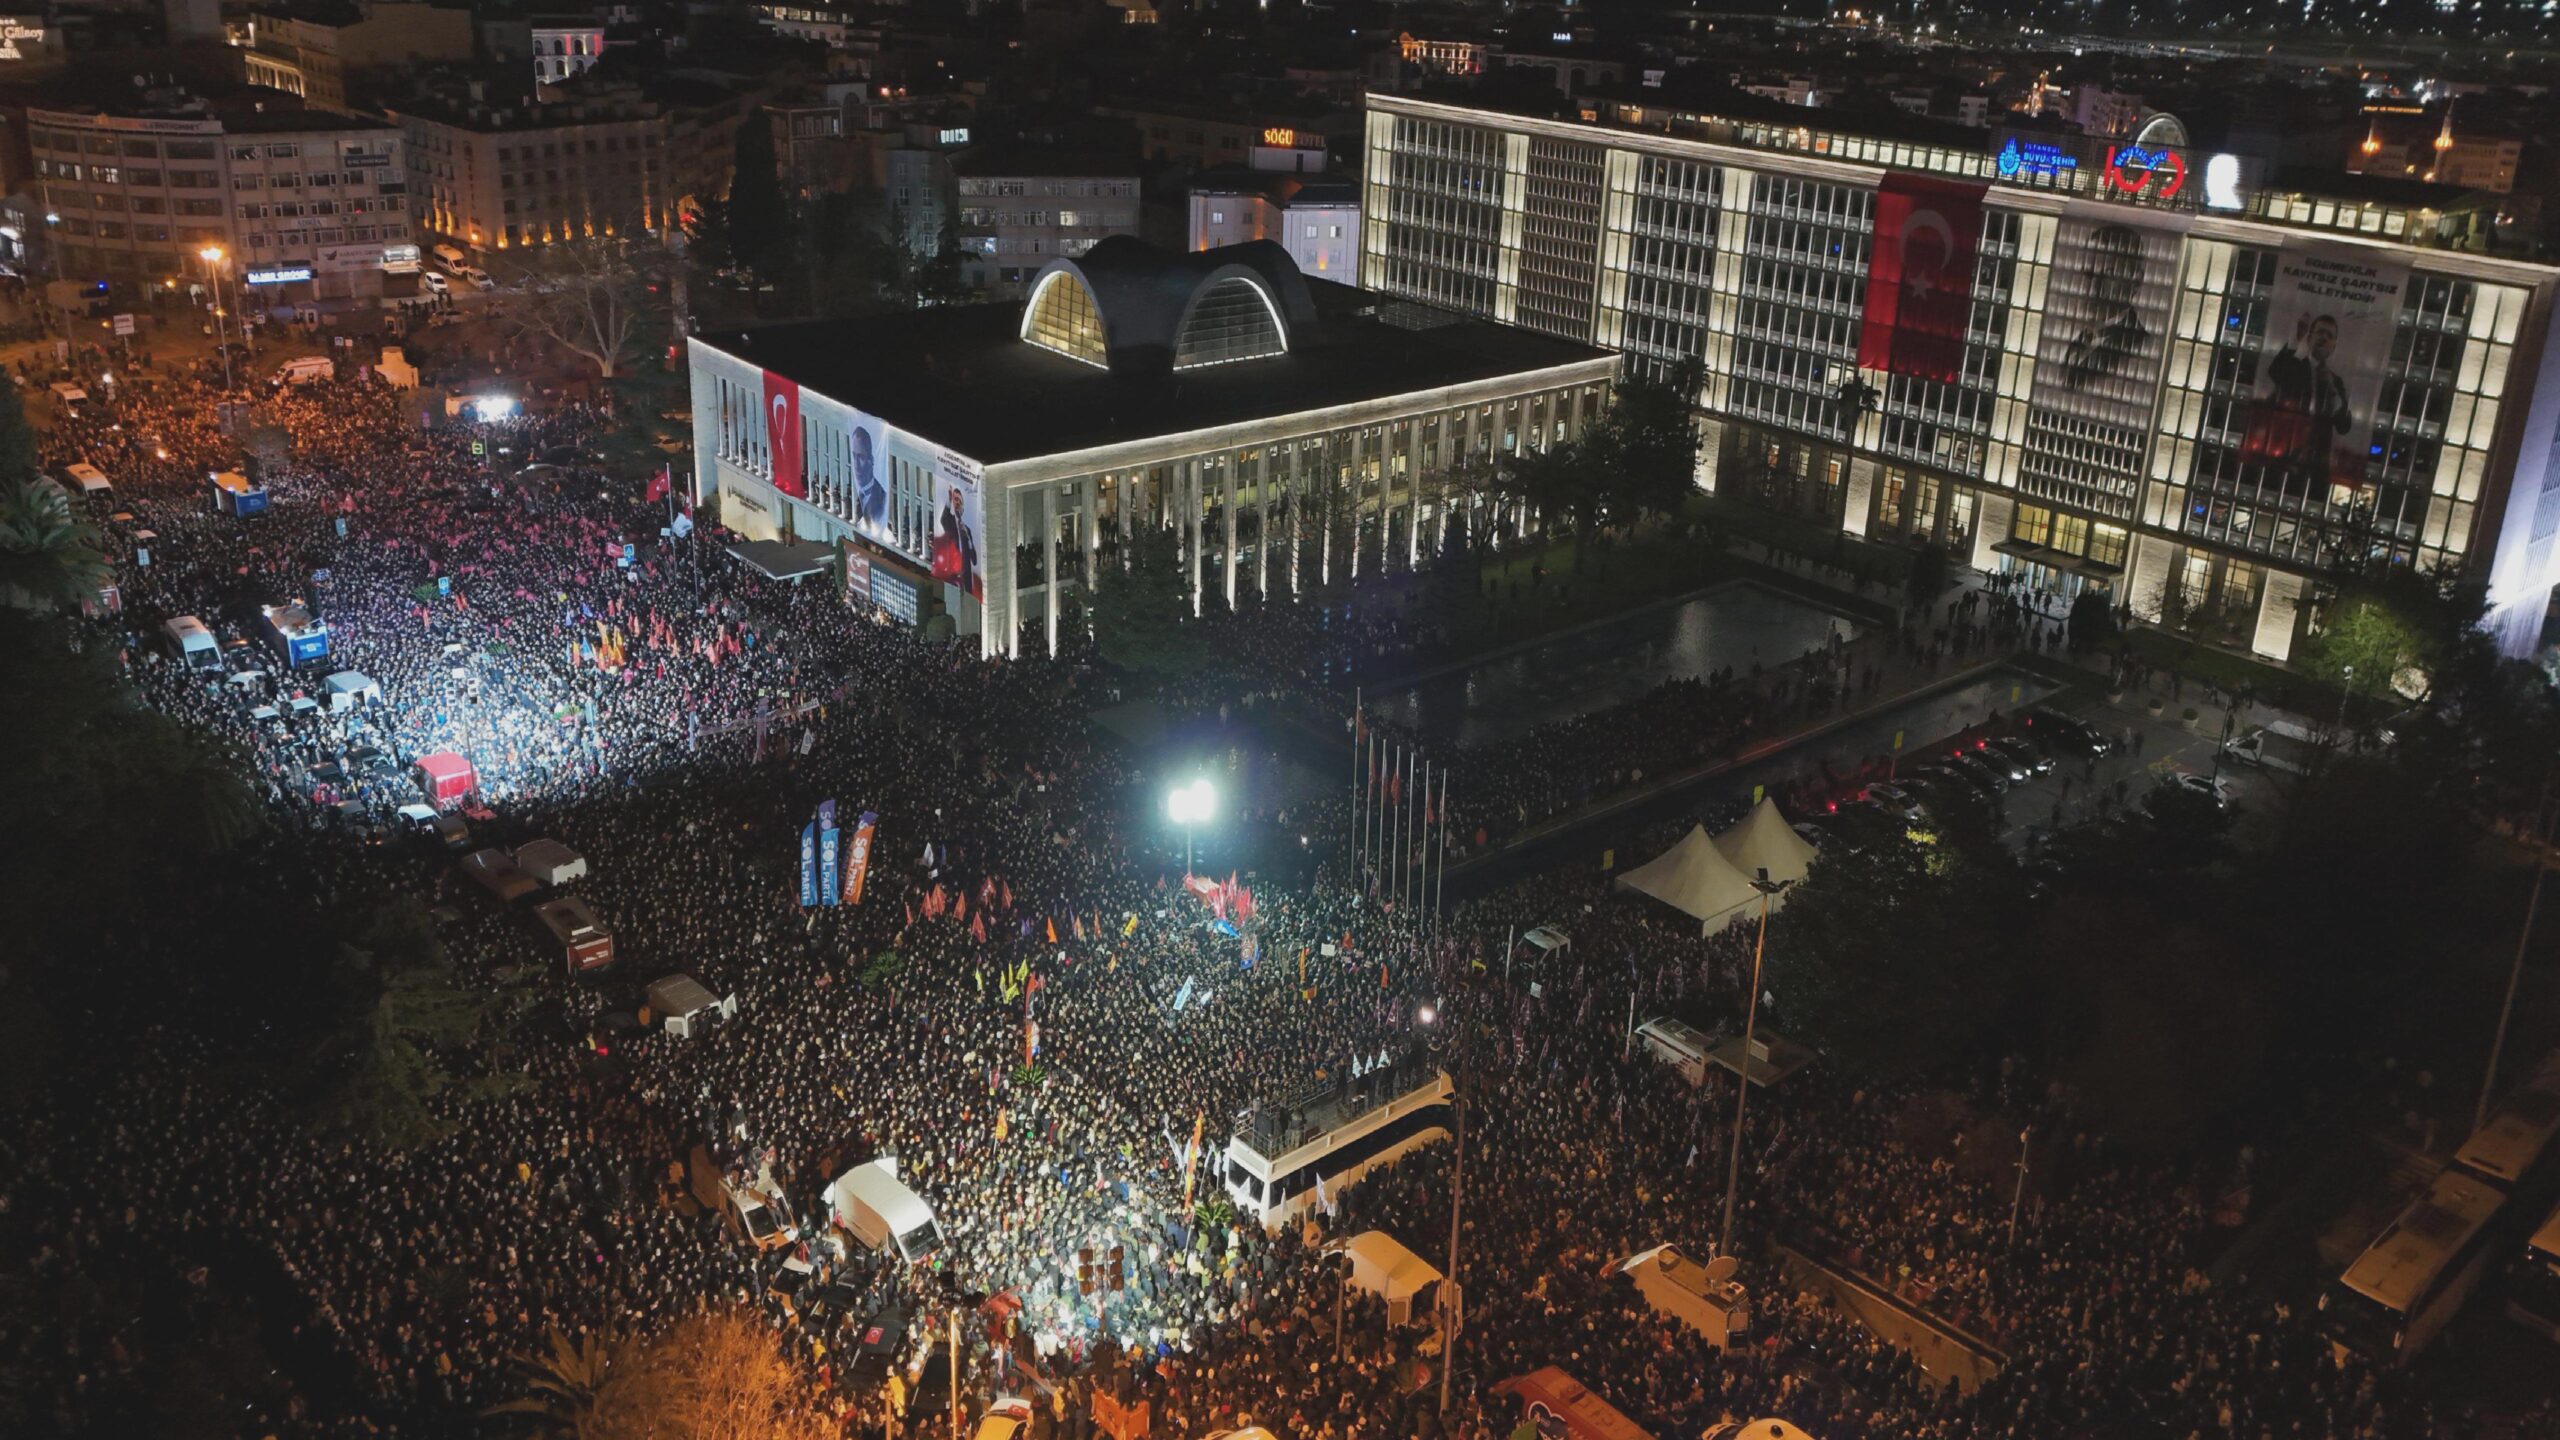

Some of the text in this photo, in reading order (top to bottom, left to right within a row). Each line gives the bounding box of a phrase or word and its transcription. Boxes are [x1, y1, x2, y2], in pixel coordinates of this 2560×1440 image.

[801, 837, 812, 870] SOL
[822, 840, 835, 871] SOL
[850, 837, 868, 867] SOL
